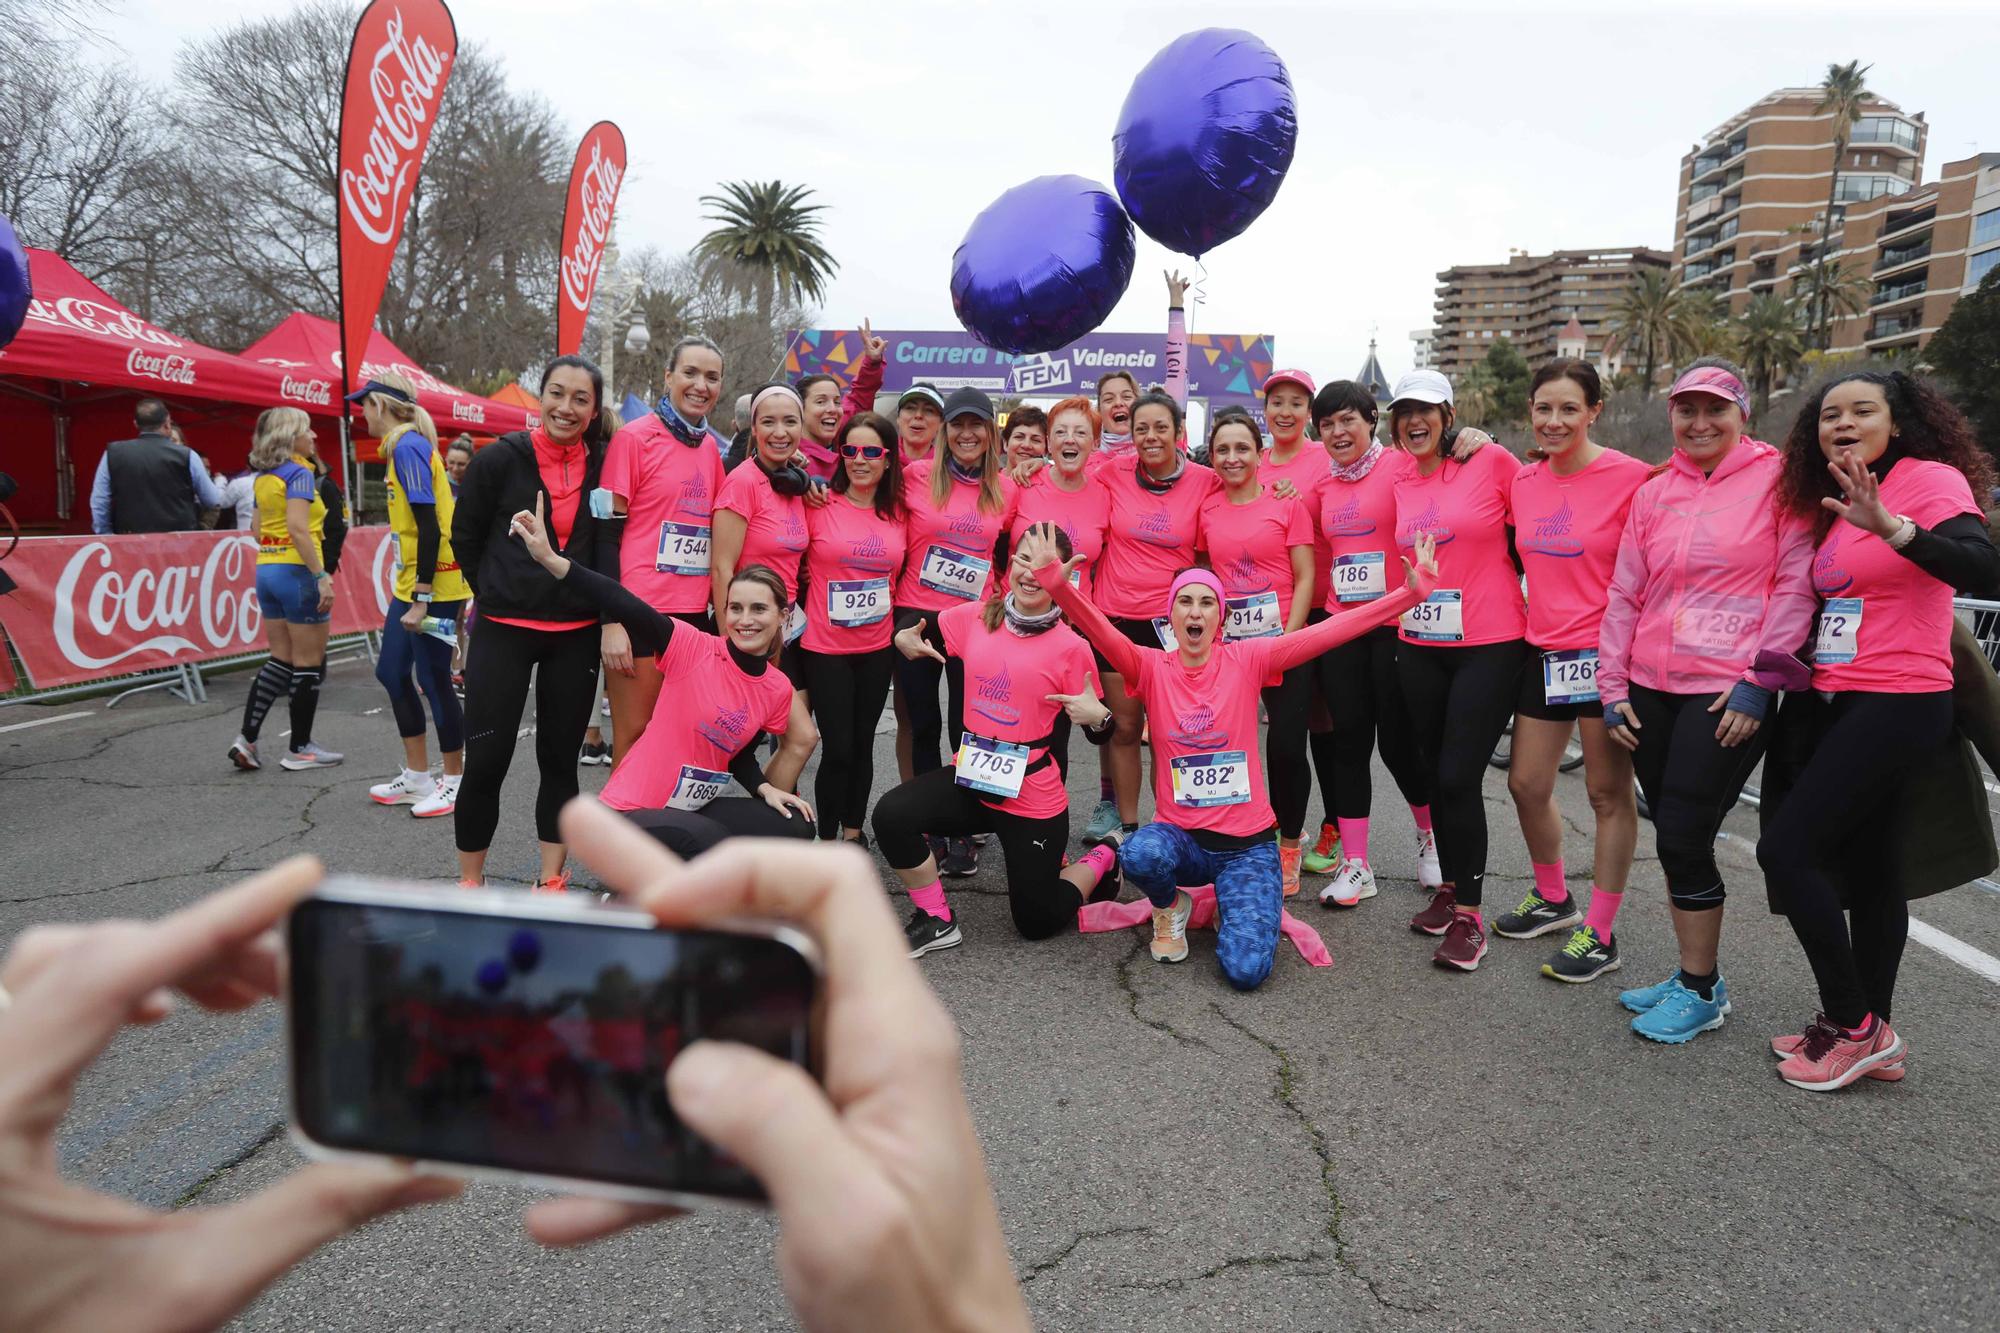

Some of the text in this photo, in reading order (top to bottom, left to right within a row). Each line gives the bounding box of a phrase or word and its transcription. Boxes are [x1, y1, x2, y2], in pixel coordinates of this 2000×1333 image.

[342, 6, 443, 245] Coca-Cola
[561, 137, 620, 312] Coca-Cola
[895, 340, 988, 365] Carrera
[1072, 348, 1157, 368] Valencia
[127, 347, 197, 386] Coca-Cola
[1019, 362, 1066, 389] FEM
[280, 374, 332, 406] Coca-Cola
[452, 400, 486, 425] Coca-Cola
[949, 519, 985, 535] velas
[1535, 523, 1573, 539] velas
[673, 537, 708, 556] 1544
[852, 546, 888, 558] velas
[936, 560, 978, 584] 1346
[1338, 566, 1369, 583] 186
[53, 535, 262, 670] Coca-Co
[845, 592, 877, 610] 926
[1233, 607, 1264, 626] 914
[1412, 604, 1442, 622] 851
[978, 684, 1012, 703] velas
[1179, 720, 1216, 733] velas
[970, 750, 1016, 775] 1705
[1193, 766, 1230, 787] 882
[686, 782, 719, 801] 1869
